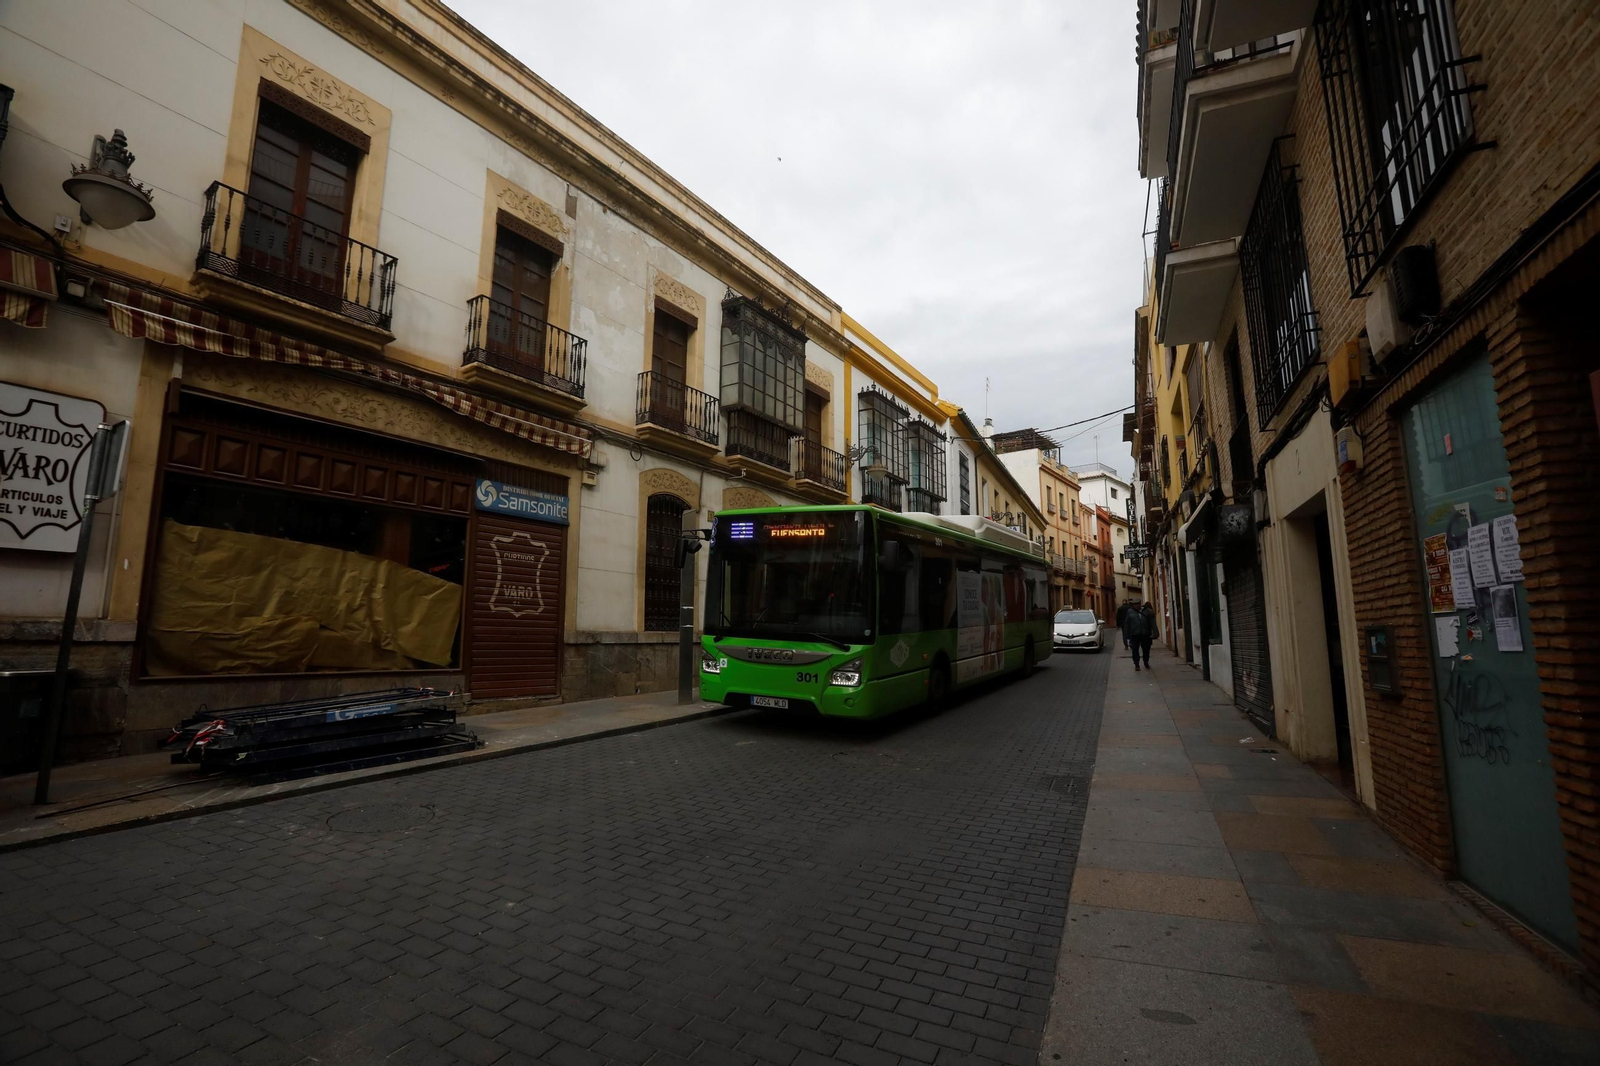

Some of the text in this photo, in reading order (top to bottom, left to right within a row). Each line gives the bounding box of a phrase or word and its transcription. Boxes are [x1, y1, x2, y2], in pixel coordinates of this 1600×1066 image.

[0, 489, 63, 505] RTICULOS
[18, 505, 27, 515] Y
[32, 506, 68, 520] VIAJE
[498, 492, 568, 519] Samsonite
[503, 584, 534, 600] VARO
[796, 672, 819, 684] 301
